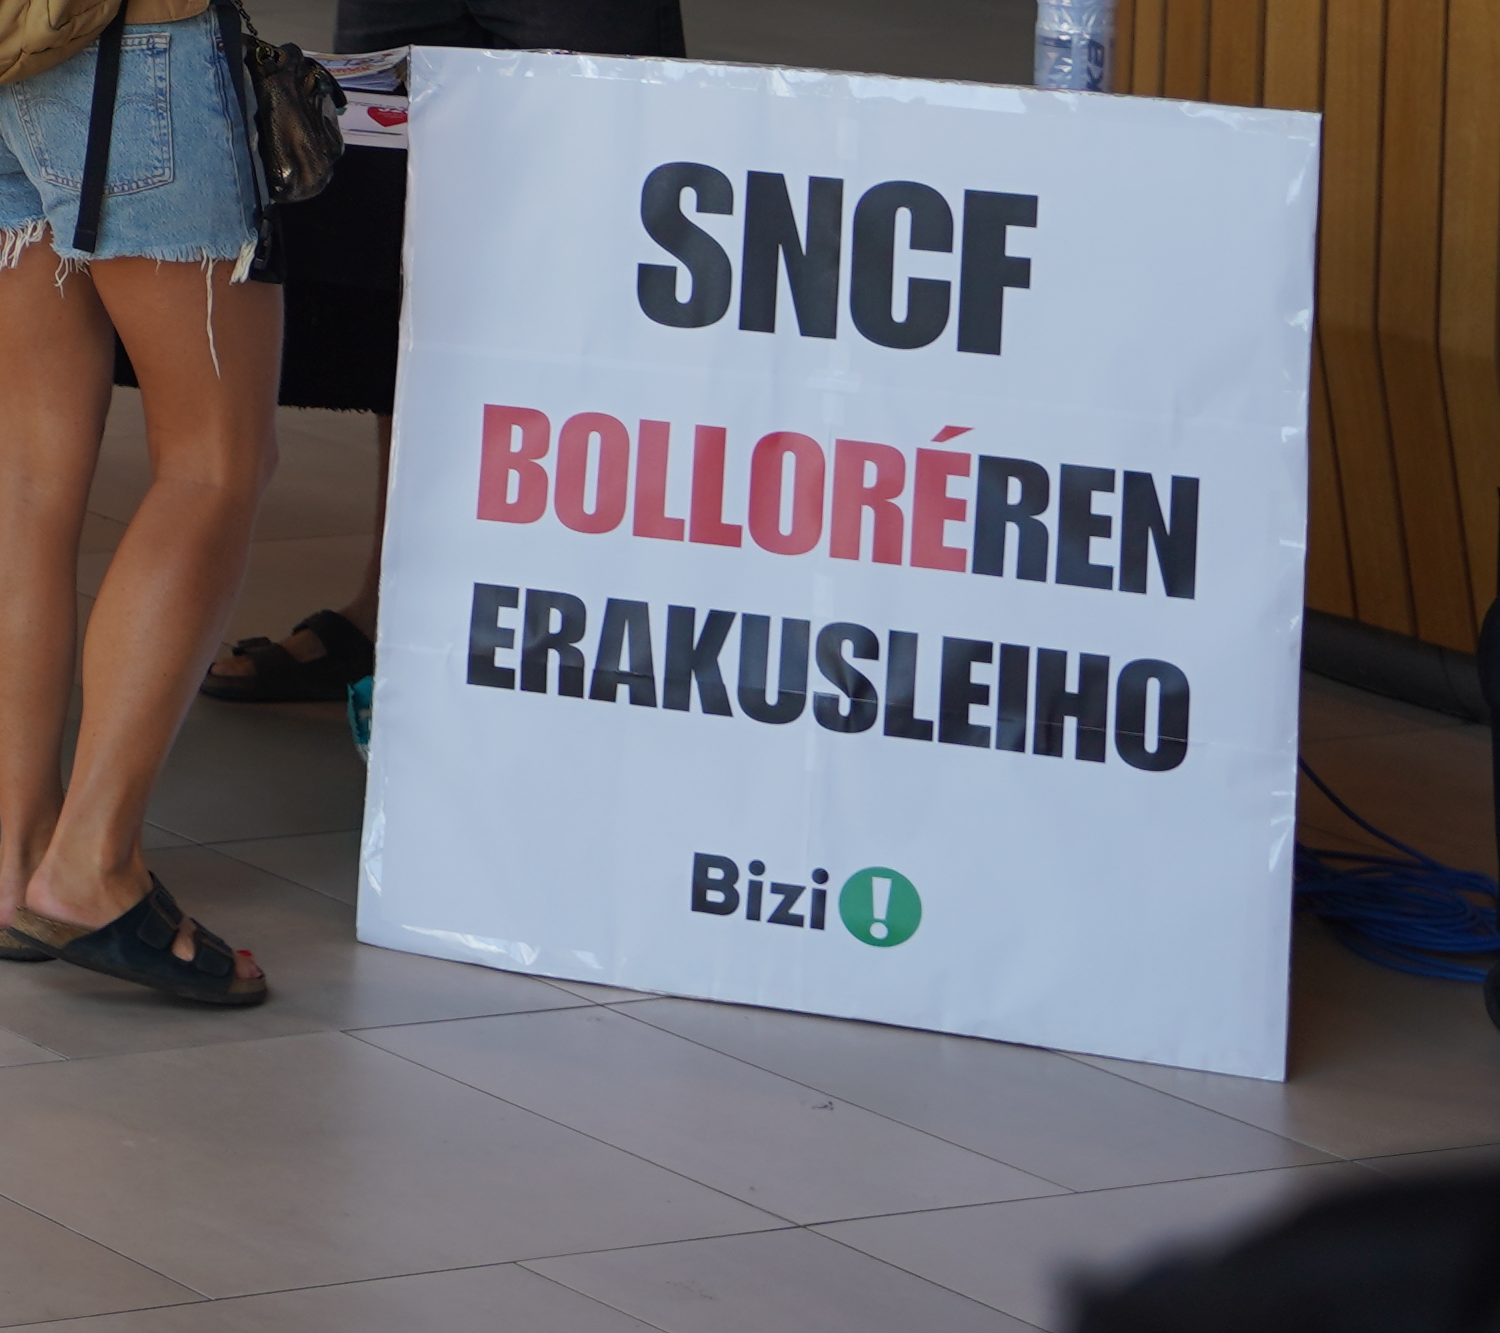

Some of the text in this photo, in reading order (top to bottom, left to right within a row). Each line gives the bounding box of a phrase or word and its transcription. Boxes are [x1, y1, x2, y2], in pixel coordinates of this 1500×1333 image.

[637, 161, 1038, 356] SNCF
[476, 403, 1200, 601] BOLLORÉREN
[466, 580, 1191, 773] ERAKUSLEIHO
